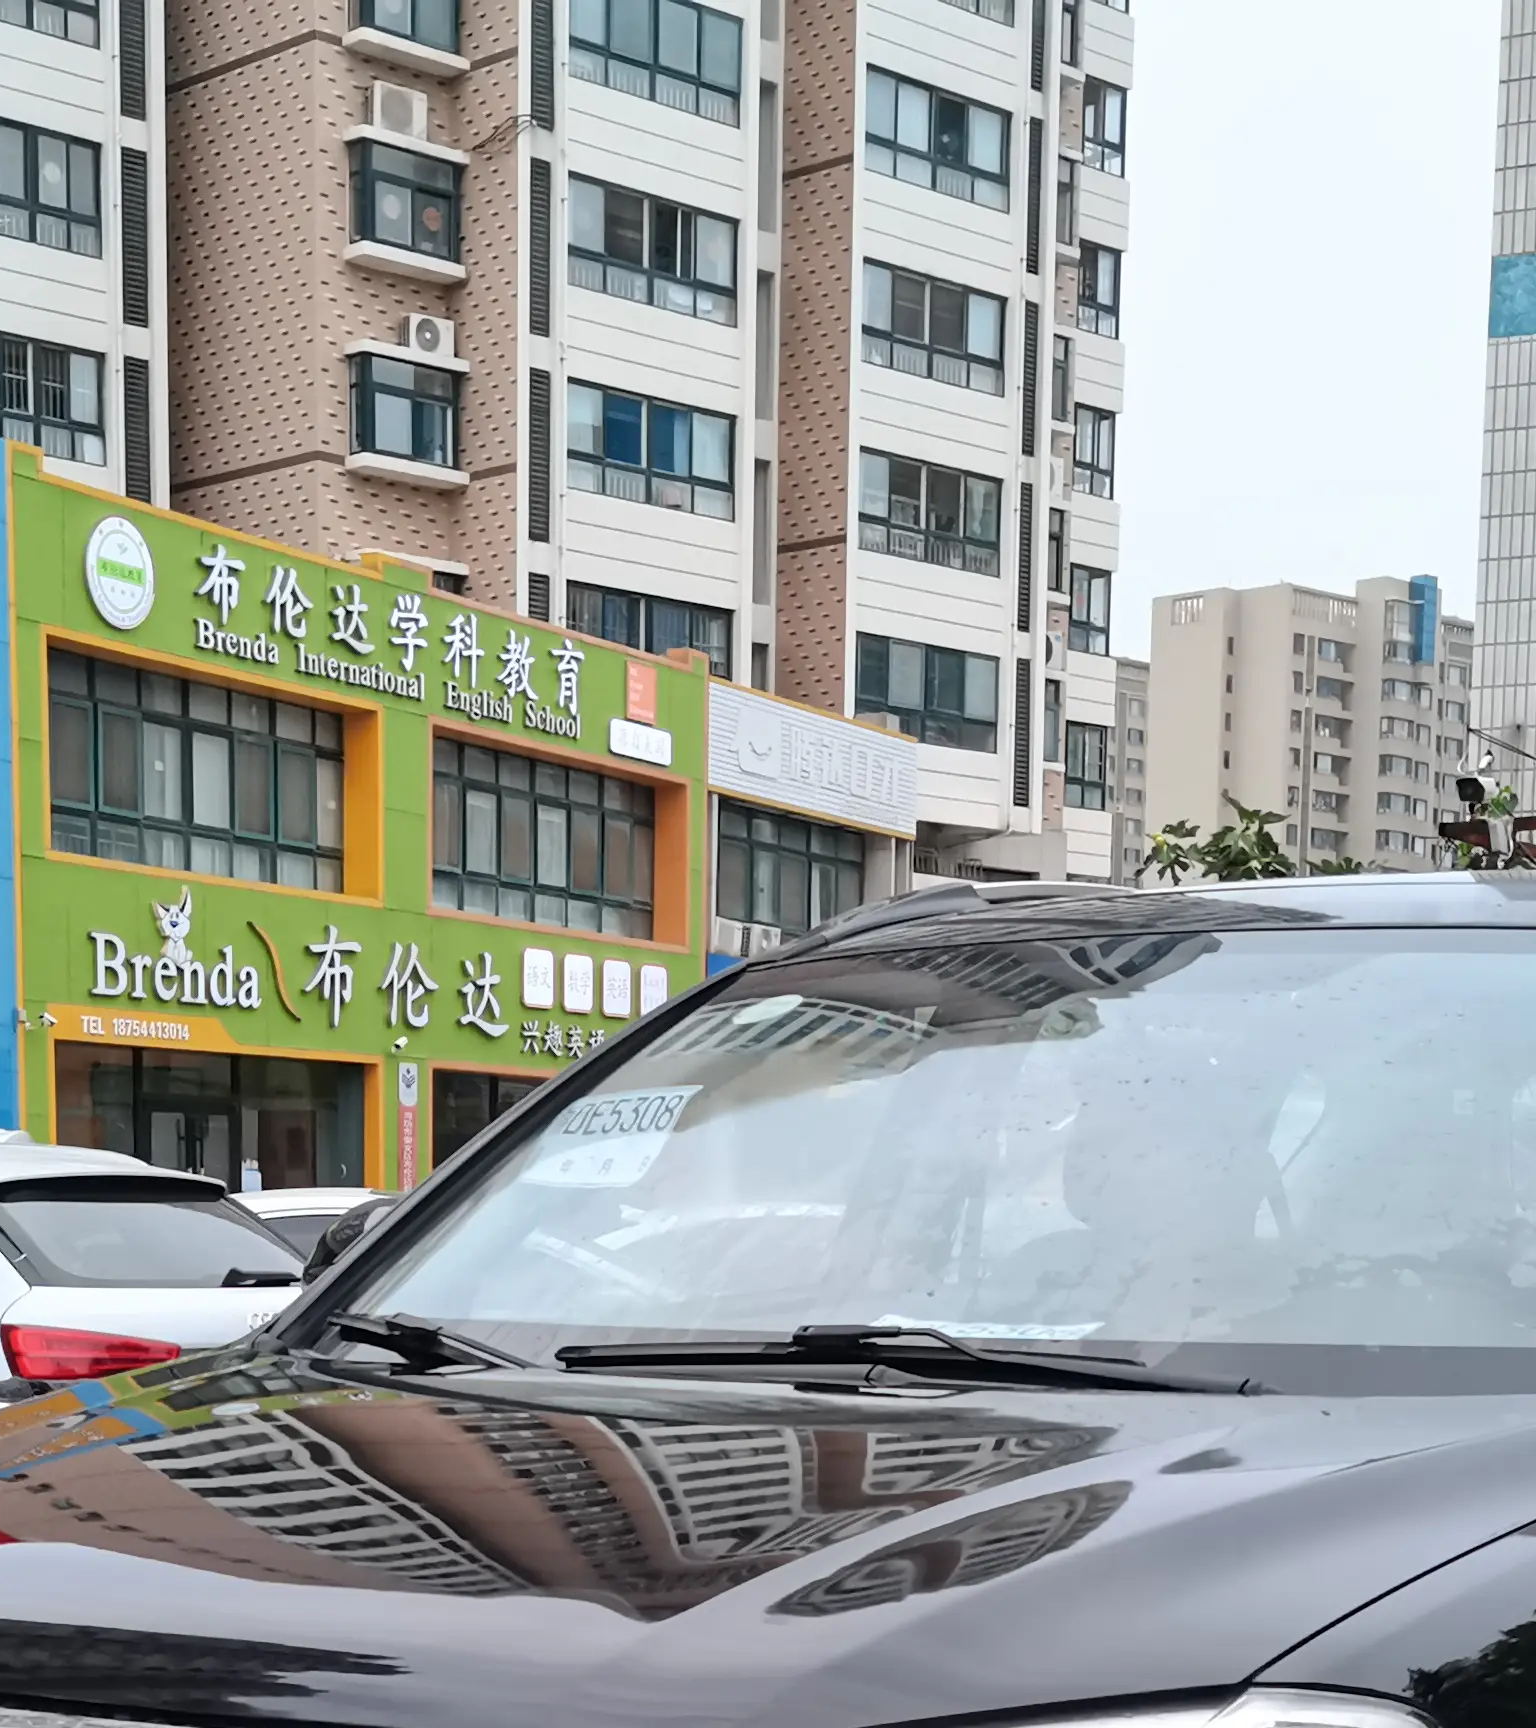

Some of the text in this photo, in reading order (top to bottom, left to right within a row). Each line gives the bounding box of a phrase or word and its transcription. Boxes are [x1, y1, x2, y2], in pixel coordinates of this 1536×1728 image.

[195, 544, 585, 716] 布伦达学科教育
[194, 617, 582, 740] Brenda International English School
[89, 925, 510, 1039] Brenda 布伦达
[526, 964, 552, 990] 语文
[567, 970, 591, 996] 数学
[605, 977, 630, 1000] 英语
[81, 1015, 191, 1042] TEL 18754413014
